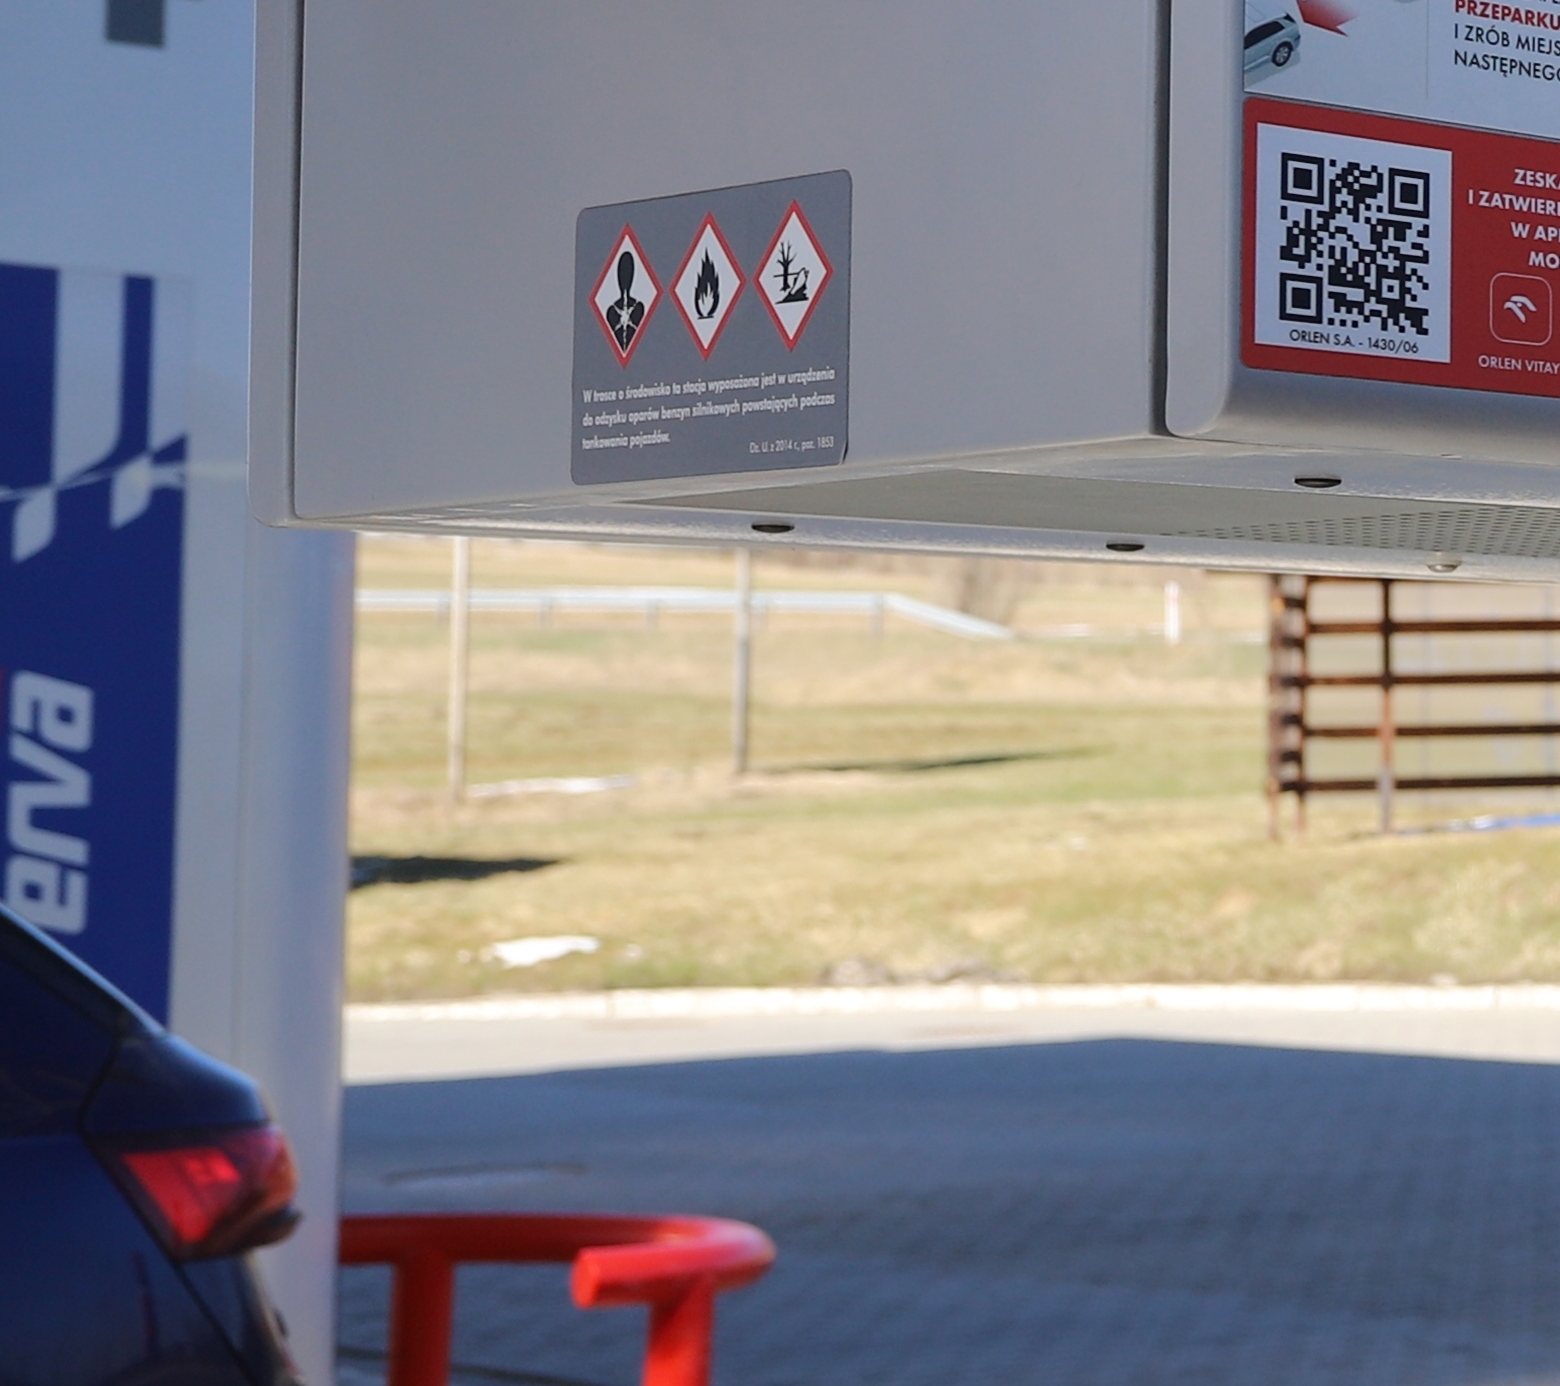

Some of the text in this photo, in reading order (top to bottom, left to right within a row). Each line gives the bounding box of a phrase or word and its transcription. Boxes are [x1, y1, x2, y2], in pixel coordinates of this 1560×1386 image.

[1465, 25, 1510, 47] ZRÓB
[1511, 221, 1530, 238] W
[1290, 329, 1329, 344] ORLEN
[1334, 333, 1354, 347] S.A.
[1368, 336, 1418, 354] 1430/06
[582, 429, 670, 450] tankowania pojazdów.
